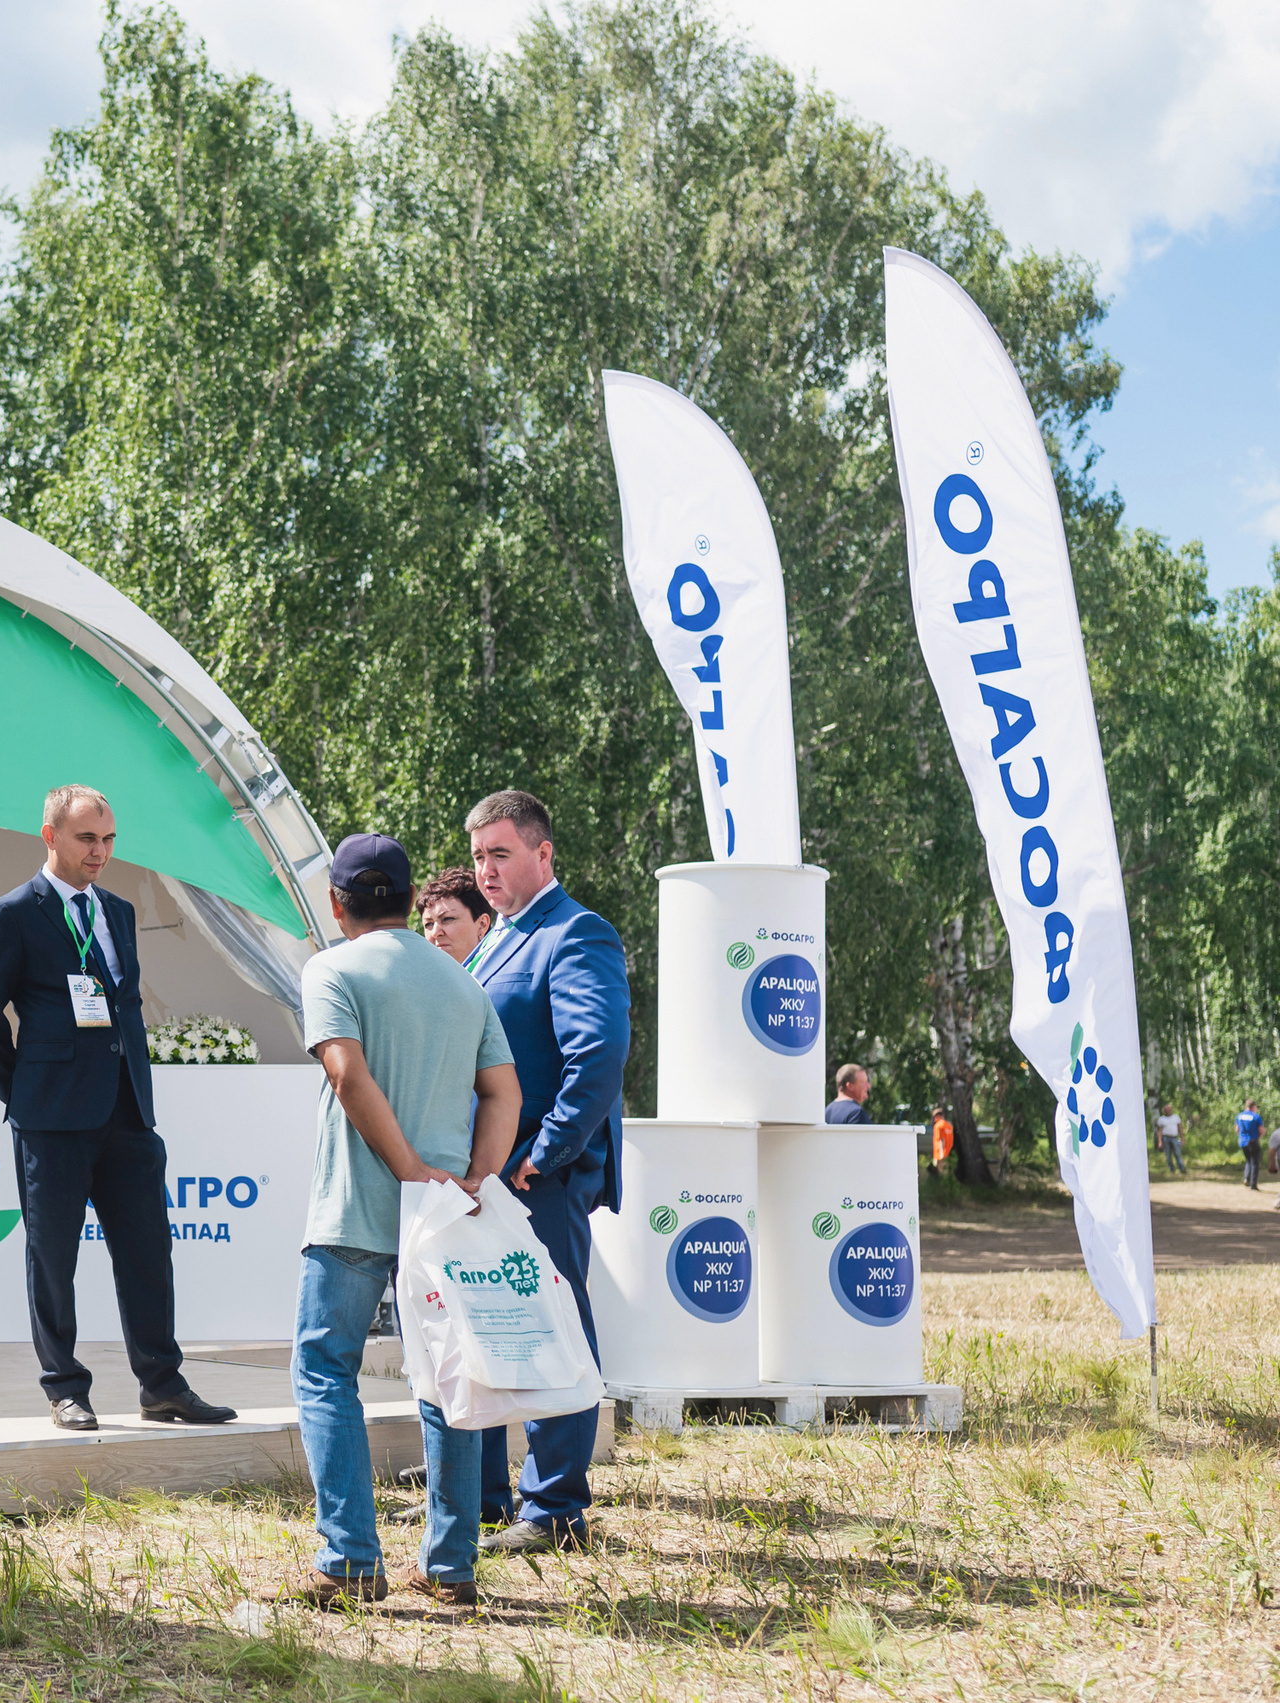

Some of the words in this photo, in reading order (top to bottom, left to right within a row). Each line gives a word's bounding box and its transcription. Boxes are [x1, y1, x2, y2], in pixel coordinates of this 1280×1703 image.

[771, 932, 814, 944] ФОСАГРО
[760, 977, 817, 994] APALIQUA
[780, 998, 805, 1011] ЖКУ
[768, 1014, 785, 1026] NP
[789, 1015, 814, 1029] 11:37
[695, 1194, 742, 1203] ФОСАГРО
[857, 1200, 904, 1209] ФОСАГРО
[684, 1241, 745, 1257] APALIQUA
[846, 1246, 907, 1262] APALIQUA
[460, 1270, 502, 1284] АГРО
[505, 1259, 534, 1281] 25
[706, 1262, 733, 1275] ЖКУ
[868, 1267, 895, 1280] ЖКУ
[515, 1279, 537, 1289] лет
[694, 1280, 712, 1293] NP
[716, 1280, 744, 1293] 11:37
[856, 1285, 875, 1297] NP
[878, 1284, 907, 1297] 11:37
